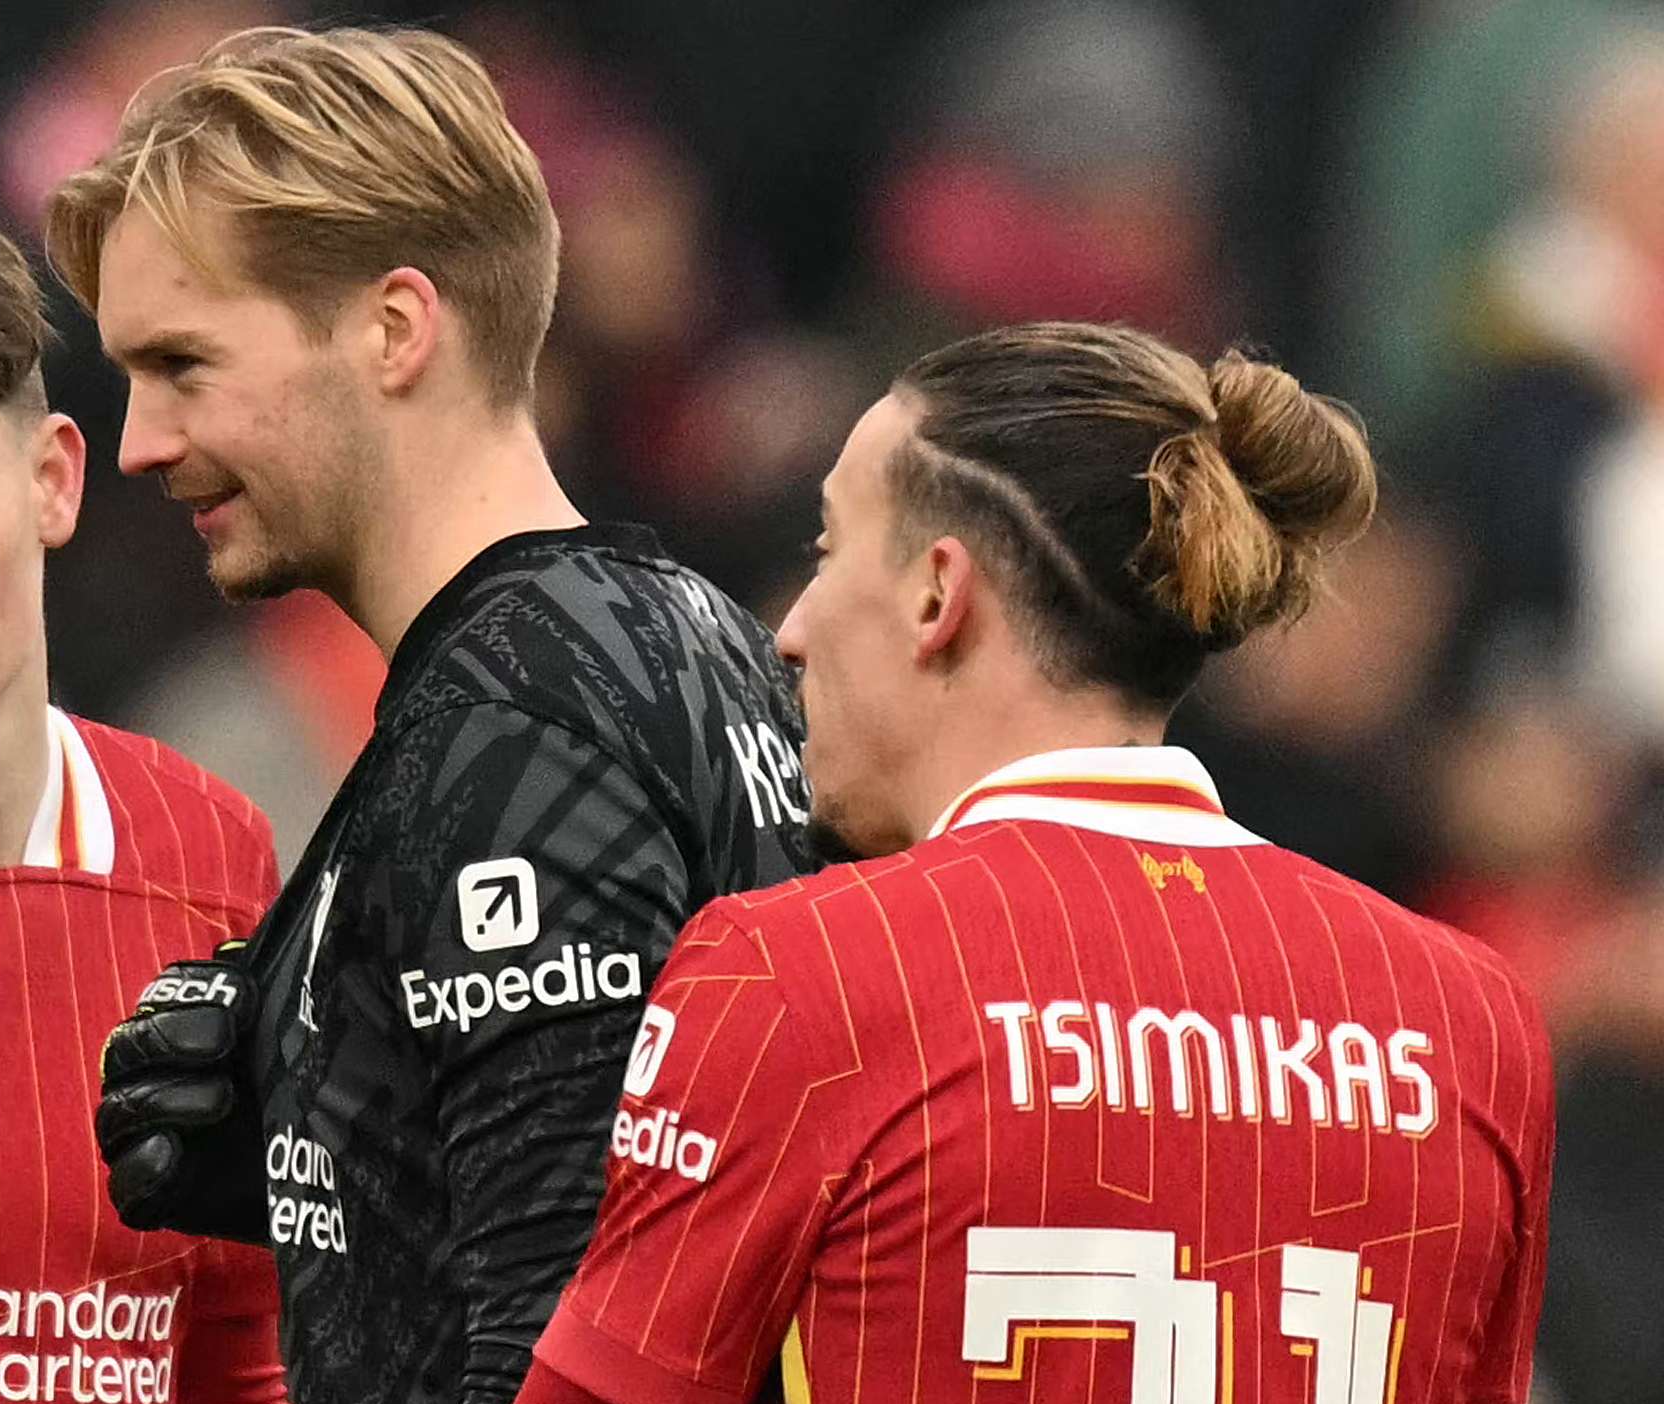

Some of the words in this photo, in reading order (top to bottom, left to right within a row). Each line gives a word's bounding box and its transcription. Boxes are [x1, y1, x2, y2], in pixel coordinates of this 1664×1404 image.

[137, 972, 237, 1007] usch
[400, 943, 642, 1032] Expedia
[984, 1000, 1439, 1139] TSIMIKAS
[266, 1123, 336, 1191] dard
[612, 1107, 717, 1182] edia
[268, 1190, 347, 1253] ered
